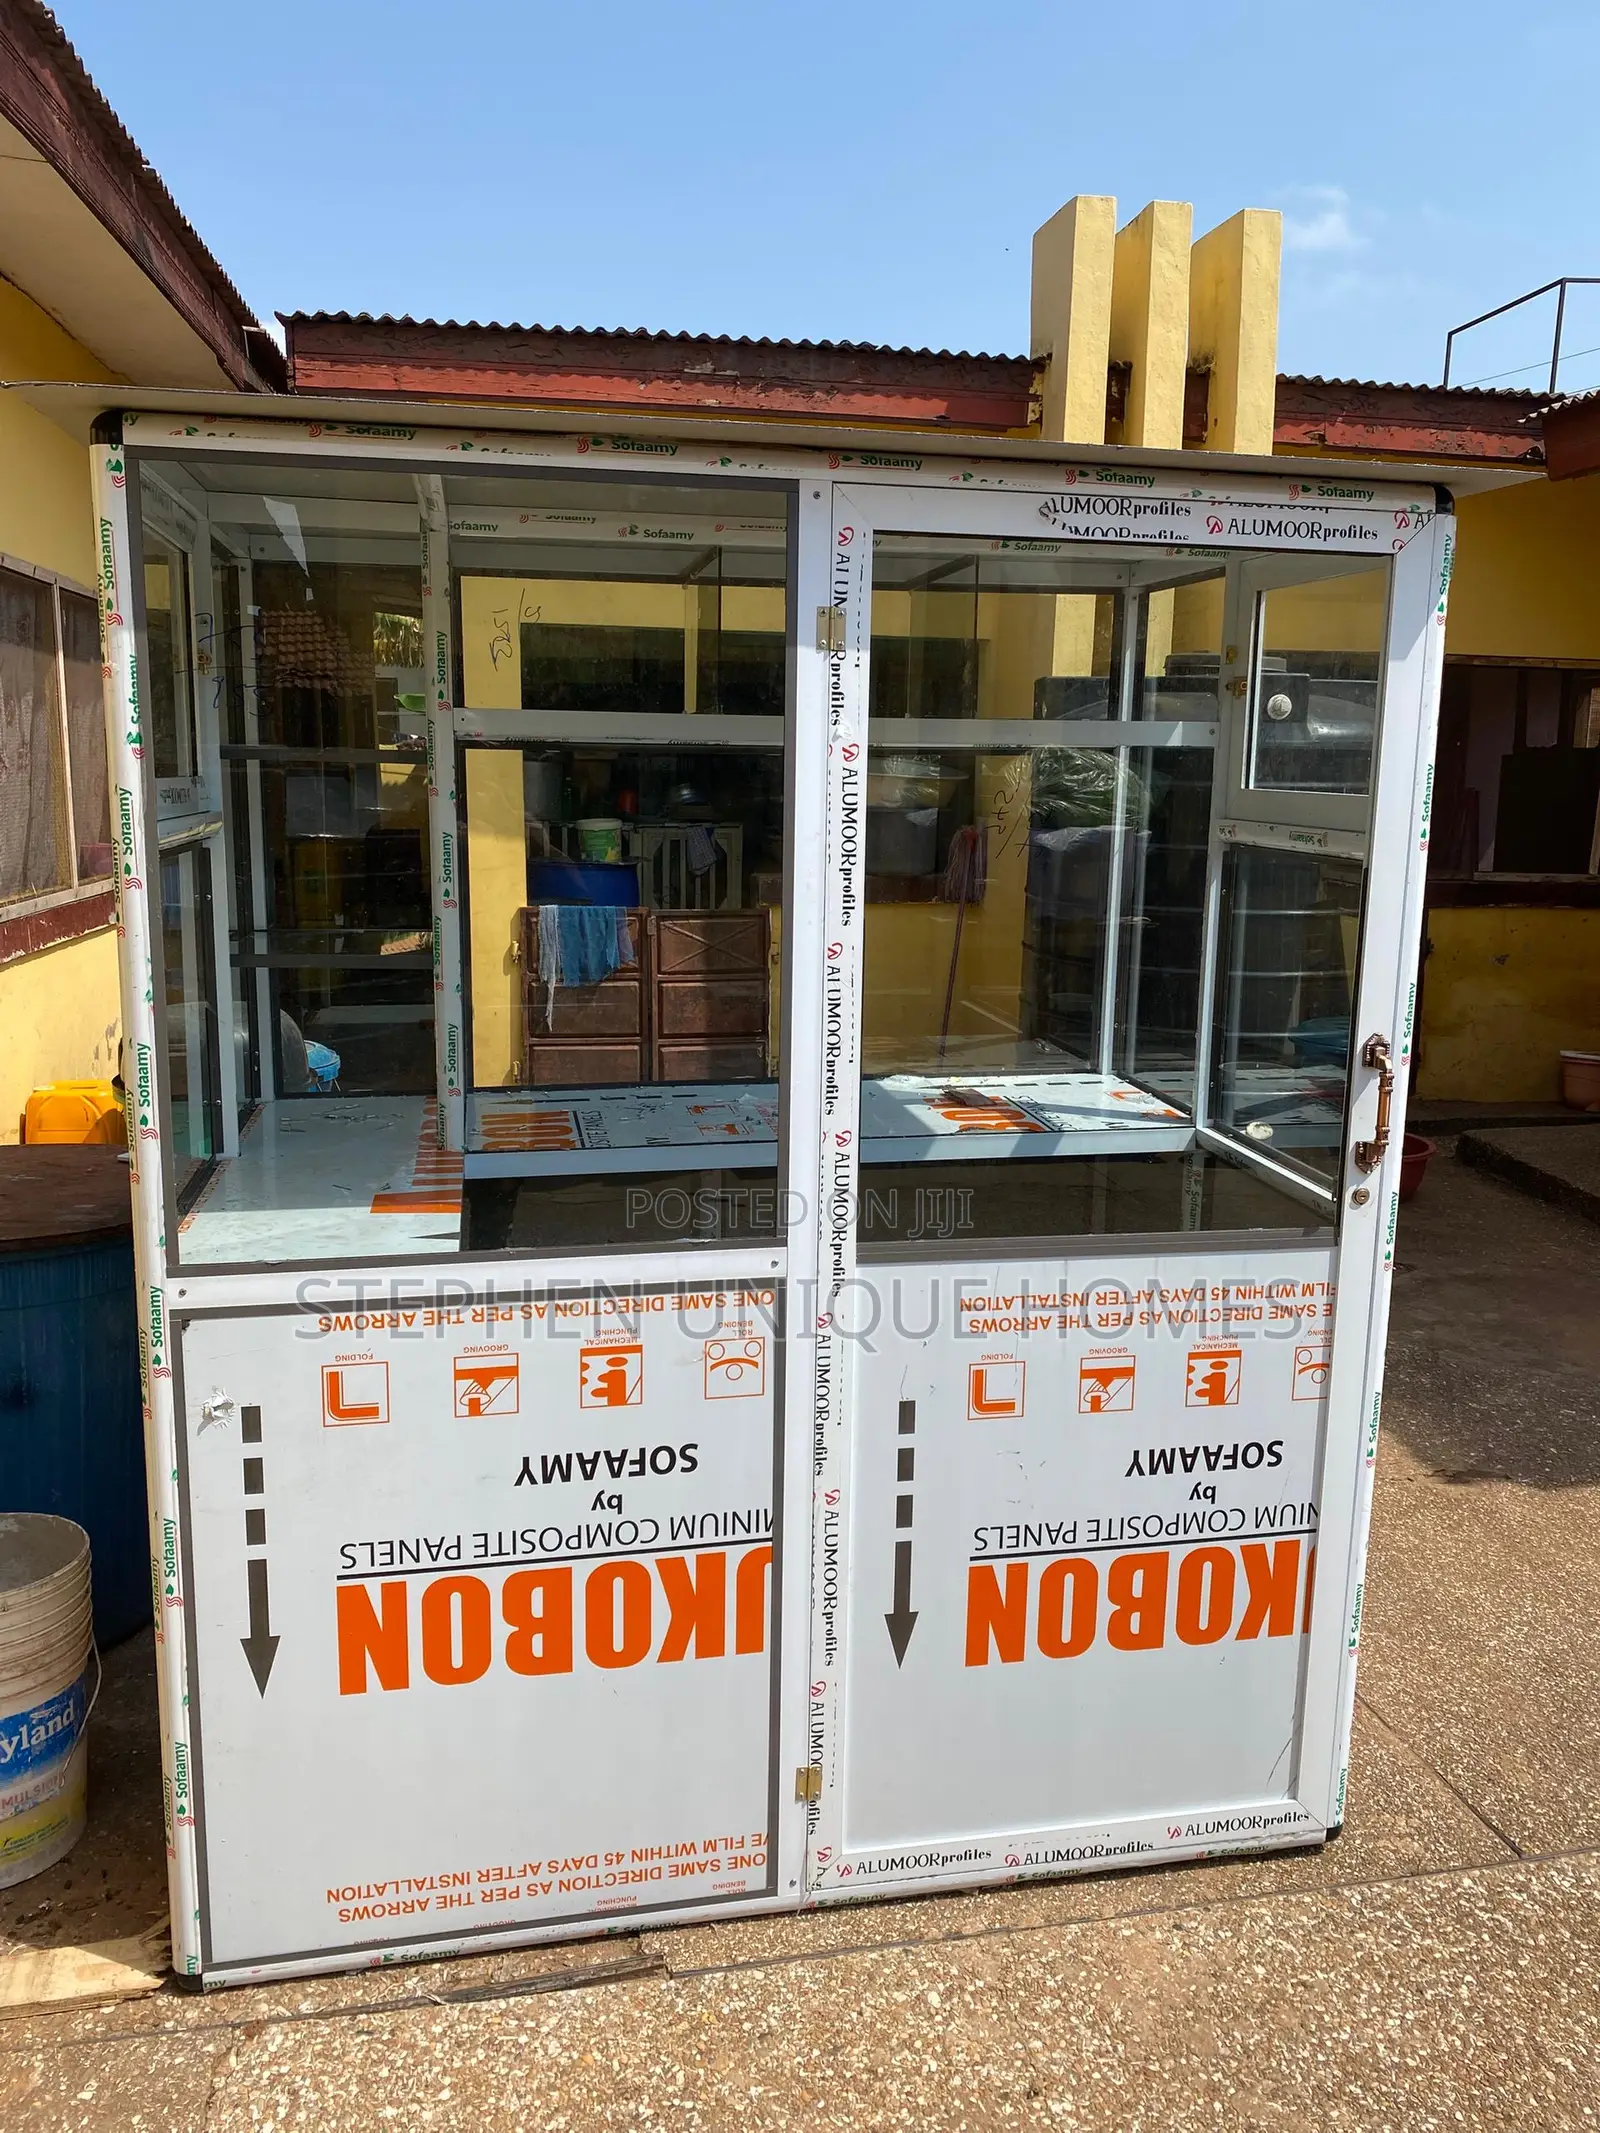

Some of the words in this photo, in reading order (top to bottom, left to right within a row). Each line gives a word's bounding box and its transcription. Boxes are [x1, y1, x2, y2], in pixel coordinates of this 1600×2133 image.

[345, 424, 417, 440] Sofaamy
[611, 438, 678, 457] Sofaamy
[860, 455, 923, 471] Sofaamy
[1096, 471, 1155, 489] Sofaamy
[1317, 485, 1374, 502] Sofaamy
[643, 528, 694, 541] Sofaamy
[1227, 517, 1378, 541] ALUMOORprofiles
[100, 518, 113, 590] Sofaamy
[1014, 541, 1062, 554] Sofaamy
[1188, 547, 1230, 559] Sofaam
[1440, 534, 1452, 595] Sofaamy
[831, 552, 850, 727] ALUMRprofiles
[437, 631, 448, 684] Sofaamy
[427, 719, 435, 771] Sofaamy
[1421, 763, 1434, 822] Sofaamy
[119, 787, 132, 855] Sofaamy
[442, 831, 453, 883] Sofaamy
[838, 767, 858, 927] ALUMOORprofiles
[112, 838, 121, 904] Sofaamy
[433, 915, 441, 965] Sofaamy
[1403, 982, 1416, 1039] Sofaamy
[448, 1023, 459, 1073] Sofaamy
[824, 965, 841, 1116] ALUMOORprofiles
[137, 1042, 151, 1108] Sofaamy
[126, 1088, 134, 1151] Sofaamy
[829, 1151, 851, 1298] ALUMOORprofiles
[1386, 1191, 1398, 1245] Sofaamy
[671, 1292, 727, 1311] SAME
[733, 1289, 775, 1307] ONE
[959, 1292, 1089, 1312] INSTALLATION
[1095, 1289, 1151, 1307] AFTER
[1159, 1287, 1206, 1303] DAYS
[1211, 1286, 1230, 1300] 45
[1235, 1284, 1297, 1300] WITHIN
[150, 1285, 164, 1348] Sofaamy
[423, 1307, 465, 1327] THE
[471, 1303, 513, 1323] PER
[521, 1303, 547, 1321] AS
[554, 1296, 665, 1319] DIRECTION
[1097, 1311, 1134, 1327] PER
[1139, 1311, 1162, 1326] AS
[1168, 1307, 1263, 1324] DIRECTION
[1268, 1304, 1317, 1320] SAME
[318, 1310, 416, 1333] ARROWS
[595, 1327, 638, 1337] PUNCHING
[717, 1320, 753, 1329] BENDING
[733, 1329, 753, 1337] ROLL
[969, 1315, 1052, 1334] ARROWS
[1057, 1314, 1092, 1330] THE
[463, 1343, 509, 1354] GROOVING
[584, 1337, 638, 1346] MECHANICAL
[1192, 1342, 1238, 1350] MECHANICAL
[1202, 1334, 1239, 1342] PUNCHING
[139, 1327, 148, 1388] Sofaamy
[334, 1353, 374, 1362] FOLDING
[981, 1353, 1014, 1361] FOLDING
[1089, 1346, 1128, 1355] GROOVING
[815, 1334, 831, 1476] ALUMOORprofiles
[1369, 1391, 1381, 1444] Sofaamy
[513, 1442, 699, 1487] SOFAAMY
[1125, 1440, 1284, 1477] SOFAAMY
[590, 1490, 623, 1515] by
[1189, 1481, 1216, 1504] by
[973, 1519, 1077, 1552] PANELS
[1086, 1509, 1246, 1543] COMPOSITE
[163, 1518, 177, 1578] Sofaamy
[472, 1519, 660, 1560] COMPOSITE
[339, 1534, 462, 1571] PANELS
[151, 1555, 160, 1614] Sofaamy
[821, 1510, 840, 1667] ALUMOORprofiles
[965, 1539, 1315, 1667] KOBON
[1352, 1583, 1363, 1633] Sofaamy
[175, 1741, 189, 1799] Sofaamy
[1336, 1767, 1347, 1816] Sofaamy
[163, 1775, 172, 1832] Sofaamy
[1185, 1811, 1310, 1838] ALUMOORprofiles
[631, 1841, 697, 1864] WITHIN
[703, 1834, 745, 1854] FILM
[1024, 1840, 1154, 1866] ALUMOORprofiles
[547, 1854, 598, 1873] DAYS
[604, 1851, 626, 1867] 45
[668, 1858, 721, 1879] SAME
[727, 1852, 767, 1871] ONE
[856, 1850, 992, 1876] ALUMOORprofiles
[477, 1861, 543, 1883] AFTER
[558, 1866, 662, 1894] DIRECTION
[326, 1871, 470, 1904] INSTALLATION
[480, 1885, 520, 1904] PER
[526, 1881, 553, 1898] AS
[712, 1879, 746, 1890] BENDING
[338, 1897, 430, 1924] ARROWS
[436, 1892, 475, 1910] THE
[596, 1895, 637, 1906] PUNCHING
[400, 1948, 460, 1962] Sofaamy
